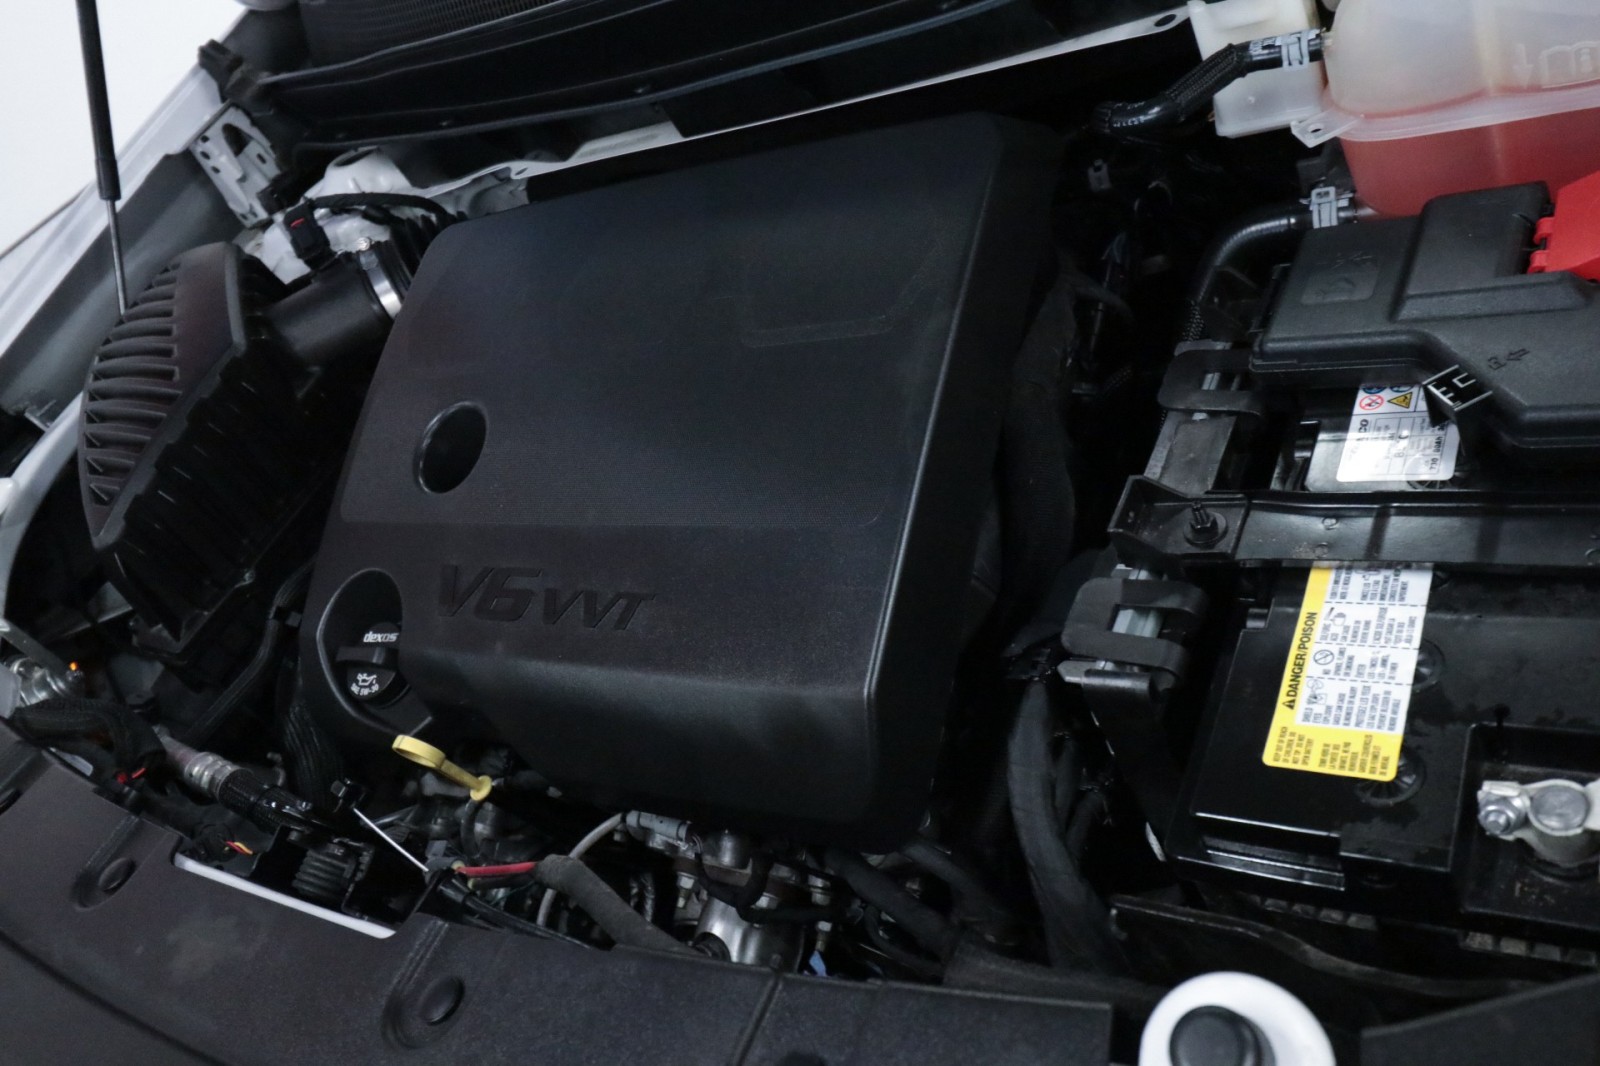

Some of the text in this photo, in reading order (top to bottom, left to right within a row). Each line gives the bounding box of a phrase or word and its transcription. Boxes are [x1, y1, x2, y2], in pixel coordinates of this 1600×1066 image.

[439, 565, 657, 630] V6 VVT
[363, 631, 399, 642] dexos
[1285, 611, 1317, 697] DANGER/POISON
